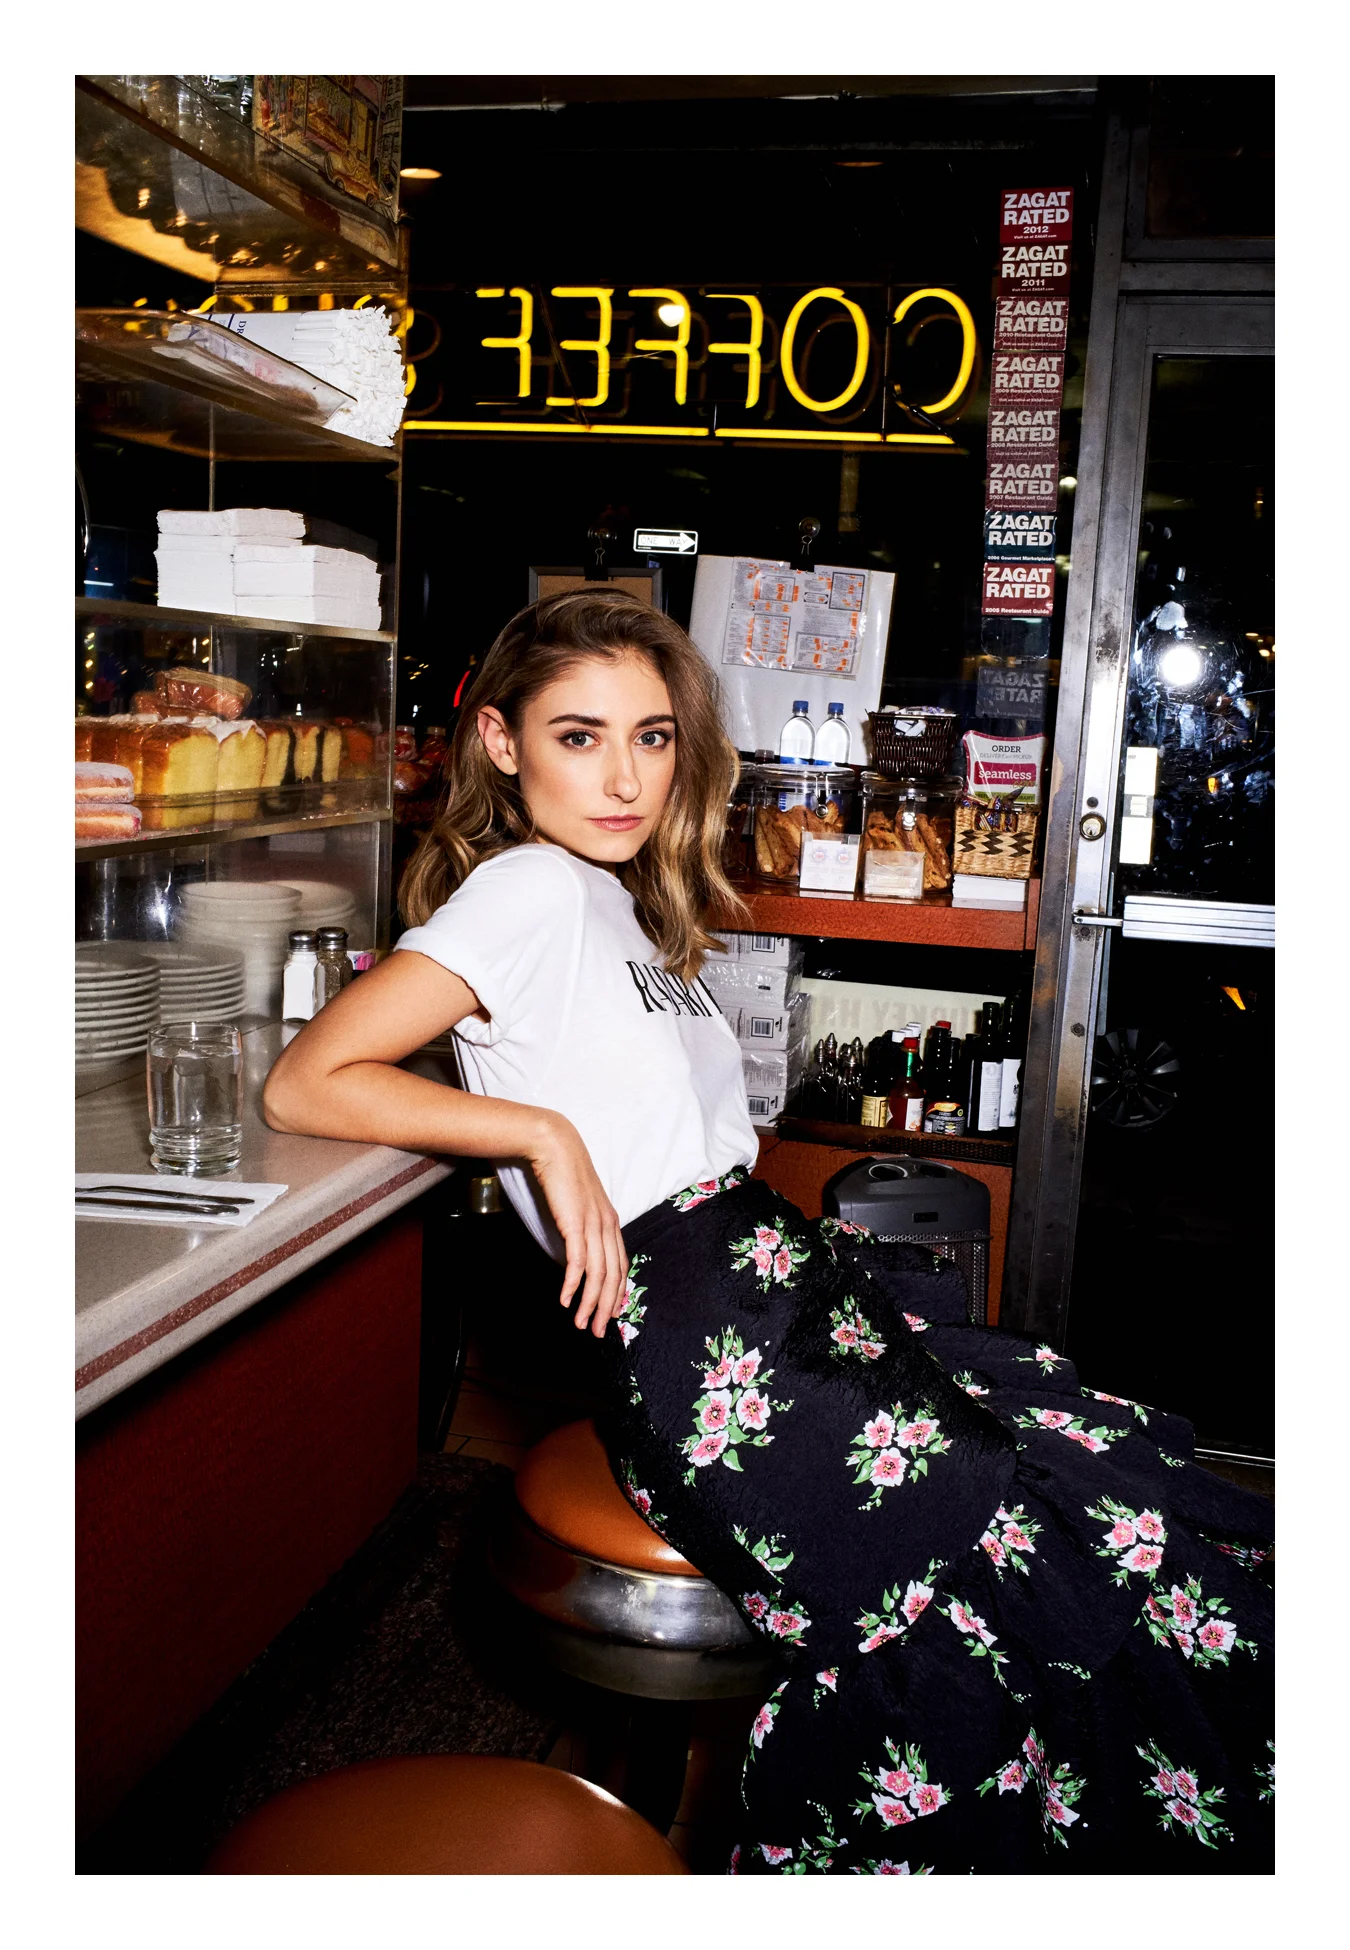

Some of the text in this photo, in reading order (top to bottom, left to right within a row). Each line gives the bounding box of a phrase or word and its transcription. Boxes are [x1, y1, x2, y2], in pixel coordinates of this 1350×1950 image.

[1004, 191, 1071, 209] ZAGAT
[1003, 208, 1070, 226] RATED
[1023, 225, 1049, 234] 2012
[1002, 245, 1069, 262] ZAGAT
[1001, 262, 1068, 278] RATED
[1021, 279, 1046, 287] 2011
[999, 300, 1067, 316] ZAGAT
[998, 316, 1065, 332] RATED
[995, 356, 1062, 372] ZAGAT
[994, 373, 1060, 388] RATED
[991, 410, 1057, 426] ZAGAT
[991, 426, 1056, 442] RATED
[989, 463, 1056, 479] ZAGAT
[989, 479, 1054, 495] RATED
[988, 514, 1055, 531] ZAGAT
[640, 536, 688, 546] ONE WAY
[988, 531, 1053, 547] RATED
[986, 567, 1052, 583] ZAGAT
[985, 583, 1051, 599] RATED
[991, 745, 1022, 753] ORDER
[978, 769, 1032, 780] seamless
